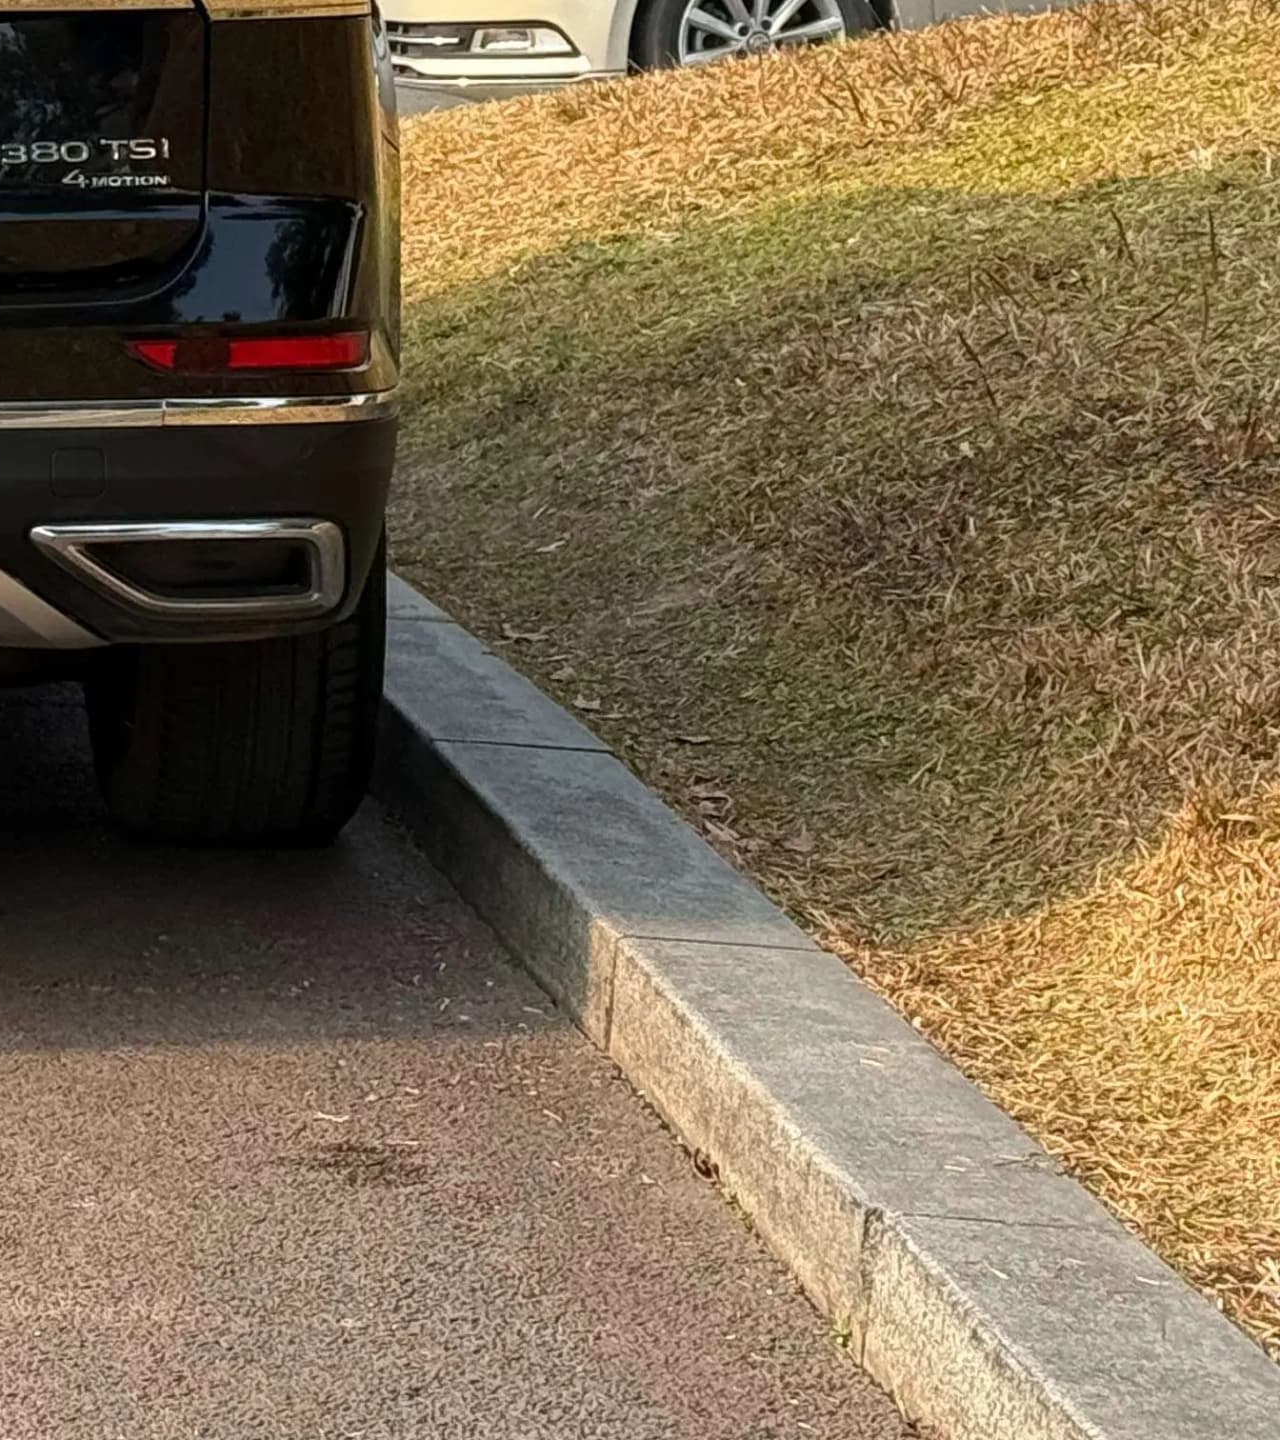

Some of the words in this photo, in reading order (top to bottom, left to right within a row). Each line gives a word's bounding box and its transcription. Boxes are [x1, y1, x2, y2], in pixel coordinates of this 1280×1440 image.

[1, 141, 90, 165] 380
[99, 137, 171, 160] TSI
[61, 168, 171, 189] 4MOTION
